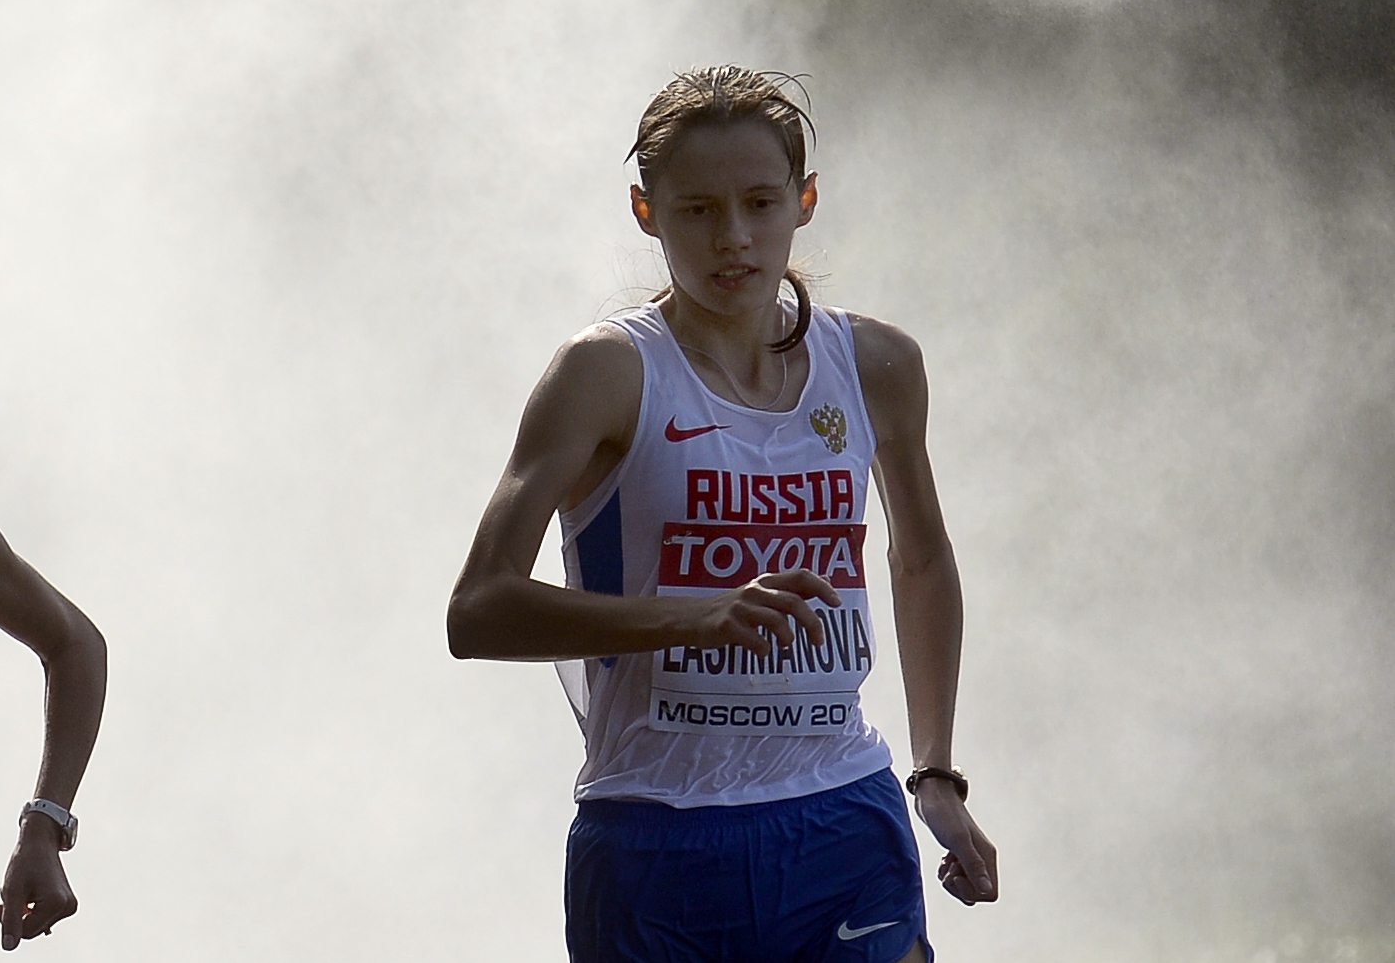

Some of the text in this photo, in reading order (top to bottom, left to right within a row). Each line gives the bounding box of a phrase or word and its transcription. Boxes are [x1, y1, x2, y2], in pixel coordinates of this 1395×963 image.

[687, 469, 853, 524] RUSSIA
[673, 537, 857, 577] TOYOTA
[657, 700, 853, 726] MOSCOW 20
